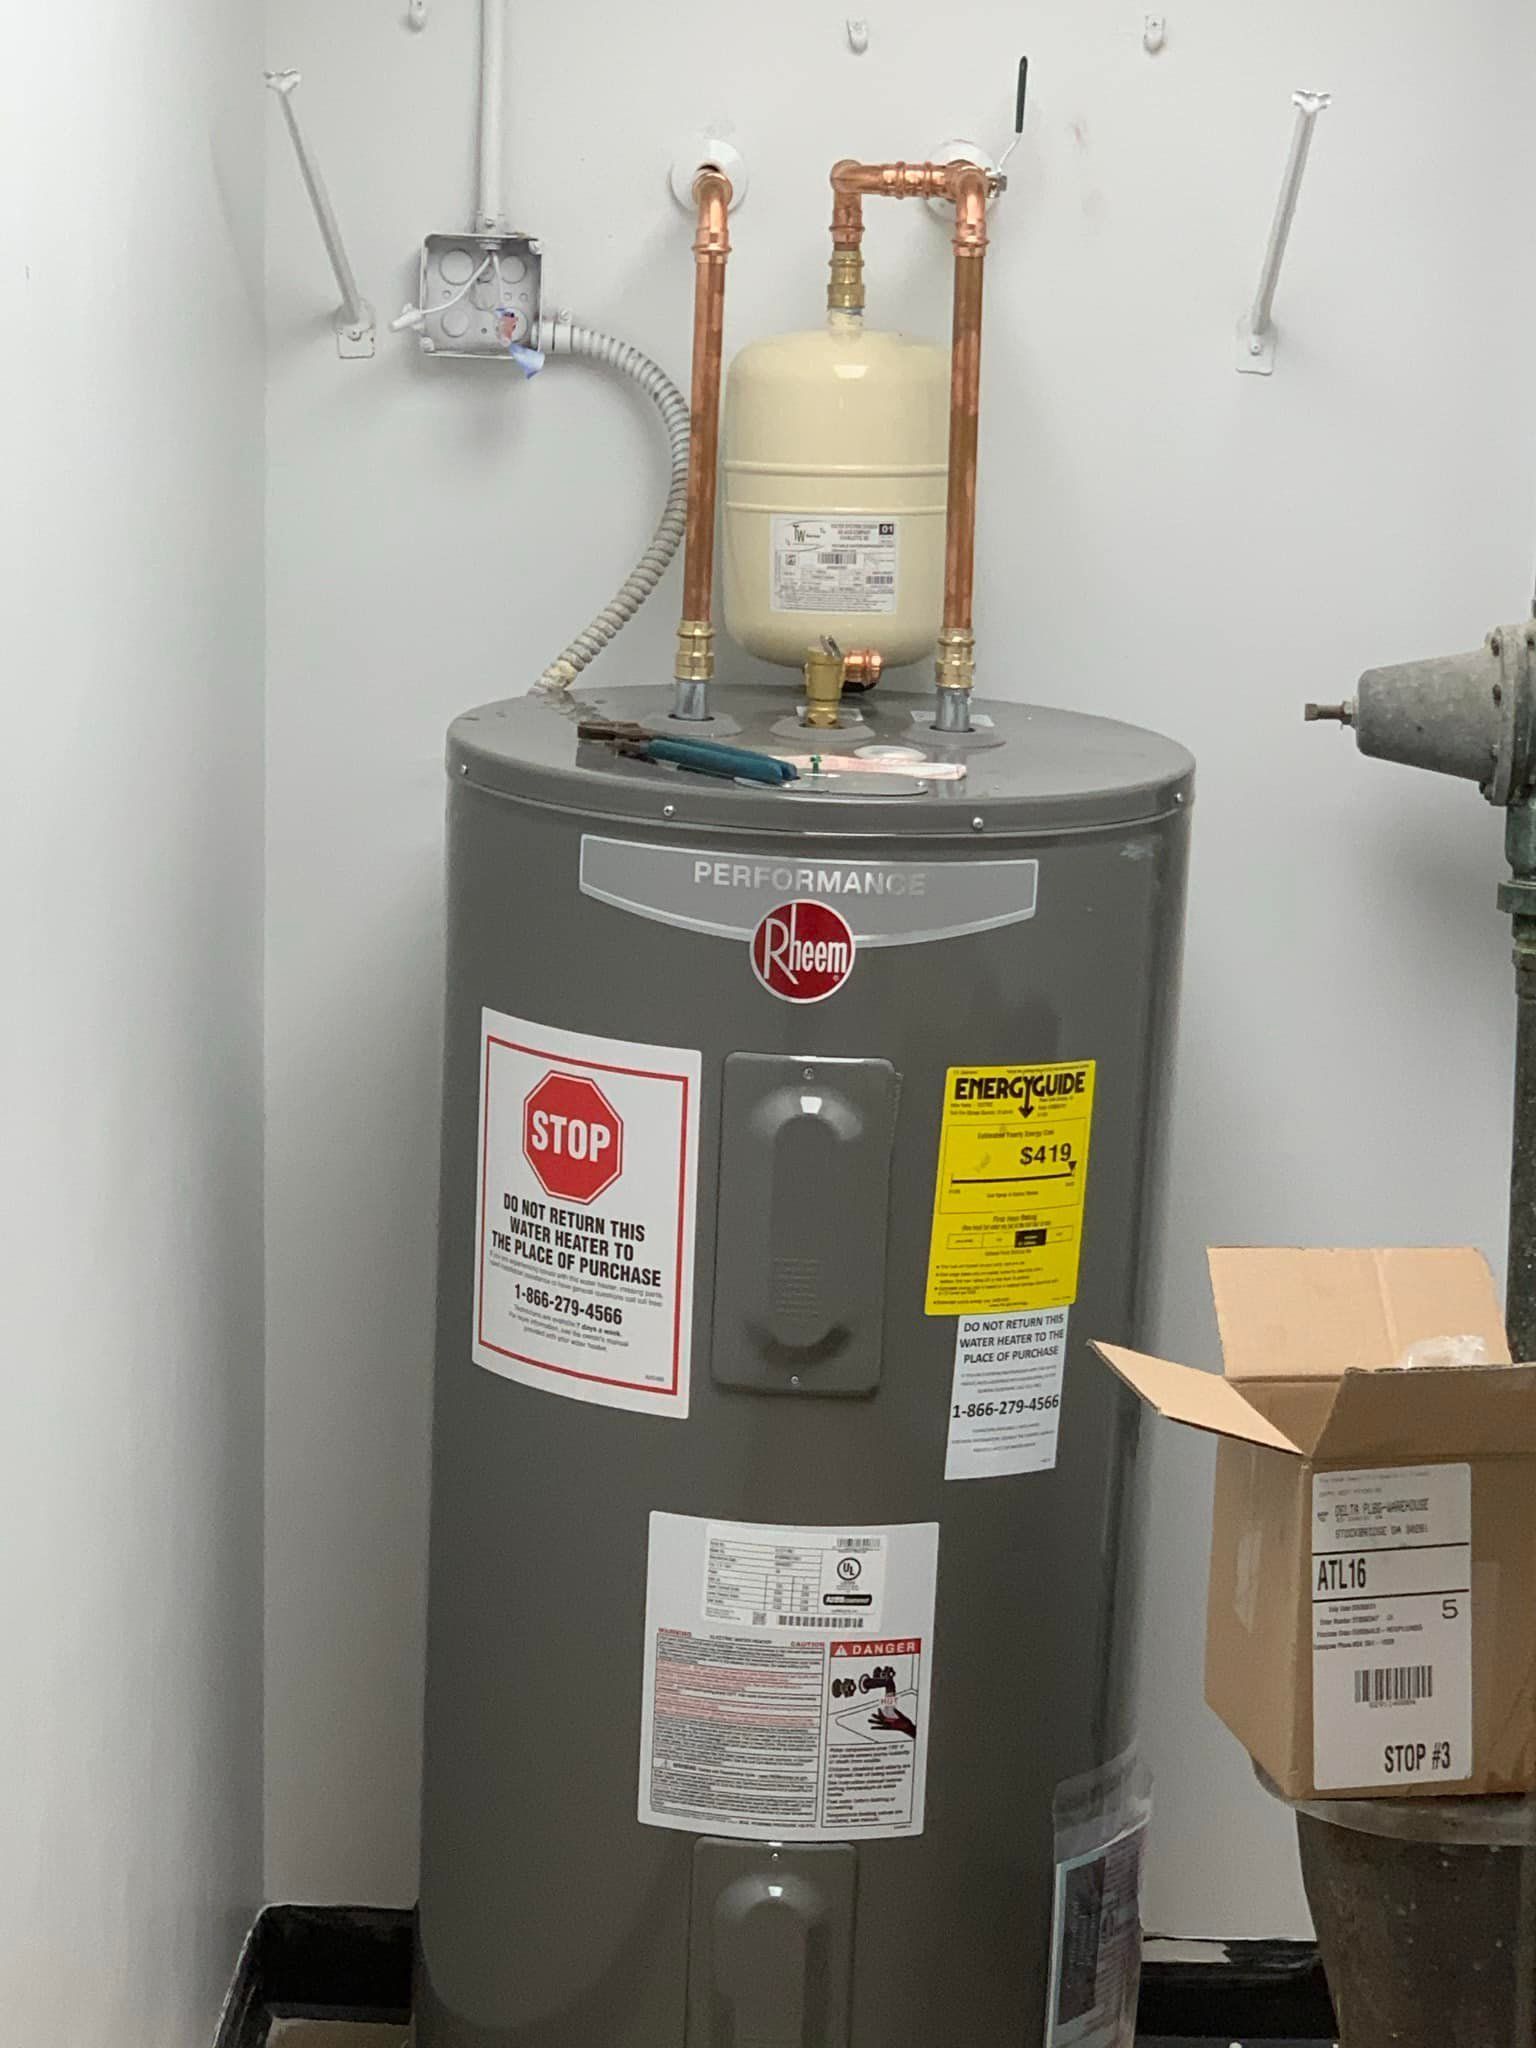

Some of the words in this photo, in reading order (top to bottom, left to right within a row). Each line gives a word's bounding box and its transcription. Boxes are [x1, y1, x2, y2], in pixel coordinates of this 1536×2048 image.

[881, 525, 894, 534] 01
[694, 861, 927, 896] PERFORMANCE
[764, 903, 847, 984] Rheem
[531, 1110, 610, 1162] STOP
[1020, 1143, 1072, 1165] $419
[503, 1193, 518, 1213] DO
[522, 1199, 546, 1220] NOT
[550, 1207, 605, 1235] RETURN
[610, 1220, 645, 1242] THIS
[510, 1216, 550, 1244] WATER
[555, 1230, 608, 1257] HEATER
[614, 1242, 634, 1261] TO
[492, 1230, 511, 1252] THE
[515, 1240, 553, 1265] PLACE
[558, 1252, 575, 1270] OF
[580, 1257, 661, 1287] PURCHASE
[515, 1284, 622, 1325] 1-866-279-4566
[960, 1337, 994, 1348] WATER
[997, 1334, 1032, 1346] HEATER
[1035, 1332, 1046, 1342] TO
[1049, 1329, 1064, 1339] THE
[964, 1322, 980, 1332] DO
[982, 1320, 1003, 1331] NOT
[1006, 1317, 1043, 1330] RETURN
[1045, 1313, 1064, 1325] THIS
[964, 1352, 994, 1364] PLACE
[996, 1350, 1010, 1362] OF
[1012, 1345, 1060, 1361] PURCHASE
[952, 1394, 1059, 1418] 1-866-279-4566
[1317, 1558, 1366, 1591] ATL16
[1442, 1599, 1459, 1619] 5
[852, 1642, 916, 1655] DANGER
[1384, 1743, 1426, 1773] STOP
[1432, 1741, 1451, 1770] #3
